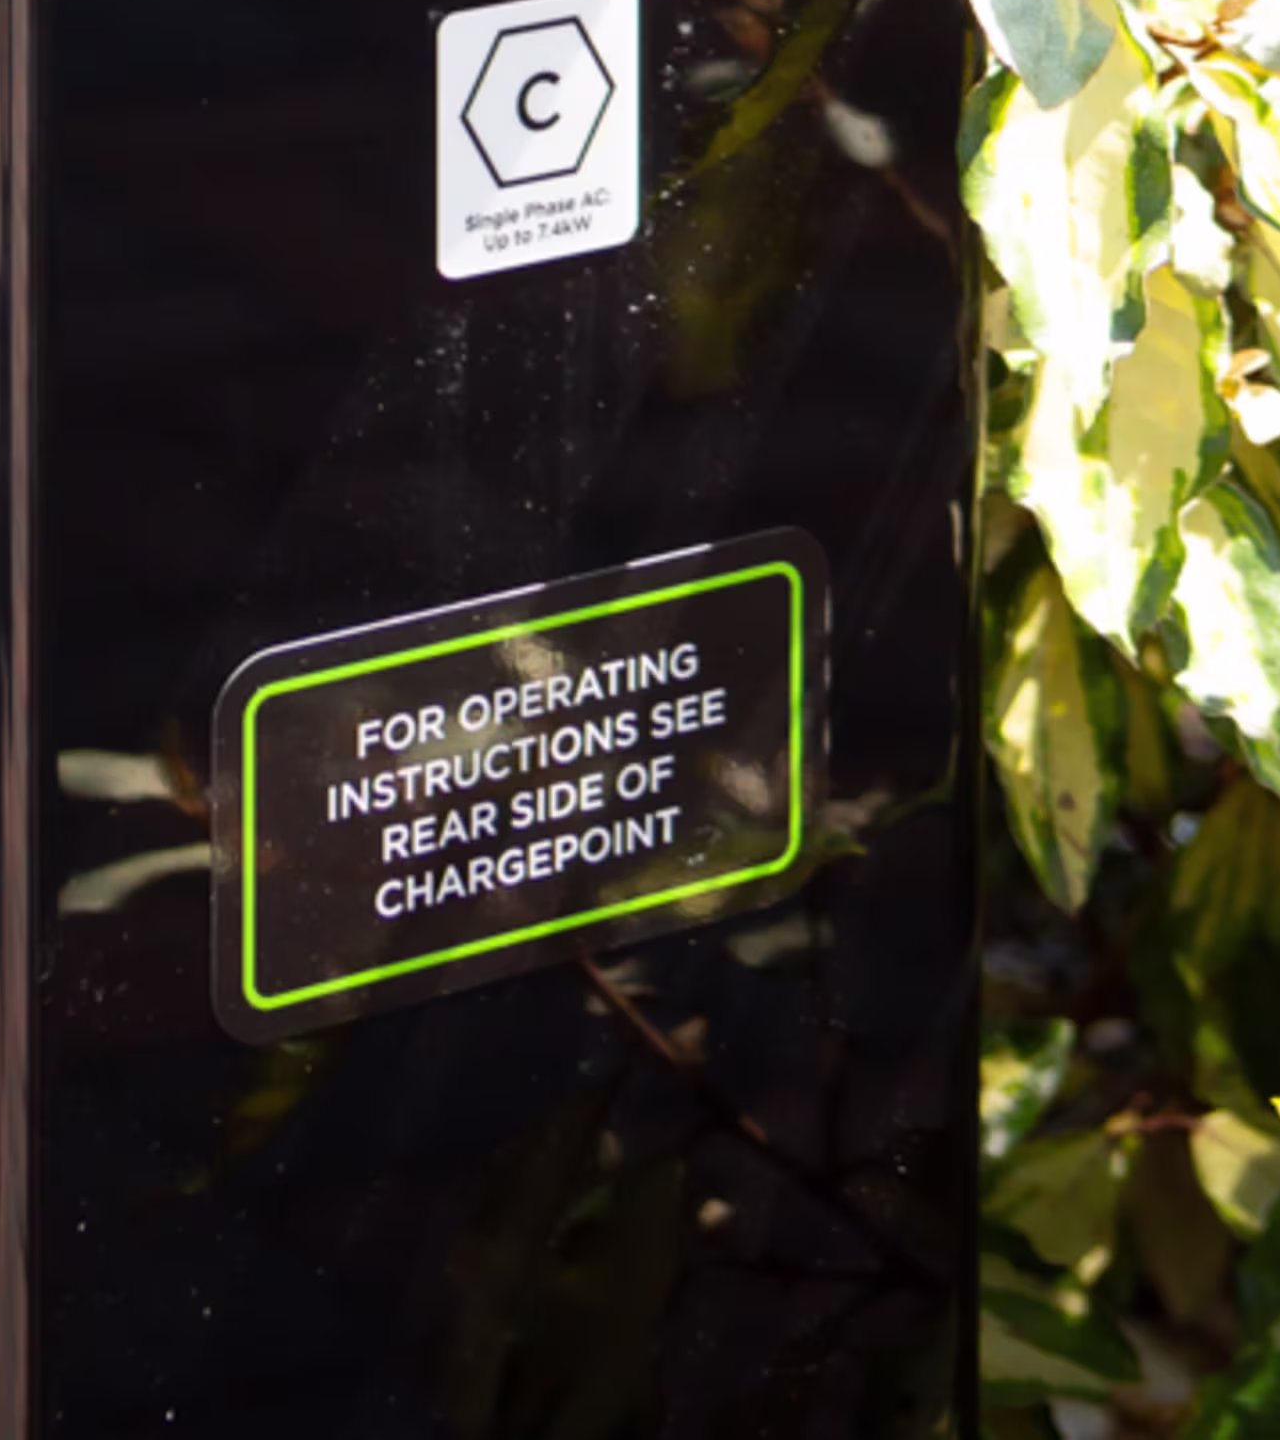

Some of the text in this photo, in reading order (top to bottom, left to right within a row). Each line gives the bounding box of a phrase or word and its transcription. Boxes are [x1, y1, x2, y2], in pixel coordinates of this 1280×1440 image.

[516, 70, 561, 131] C
[465, 208, 520, 233] Single
[524, 197, 576, 218] Phase
[482, 213, 592, 253] Up to 7.4kW
[327, 688, 727, 822] INSTRUCTIONS SEE
[356, 643, 699, 759] FOR OPERATING
[373, 806, 681, 918] CHARGEPOINT
[381, 755, 675, 863] REAR SIDE OF
